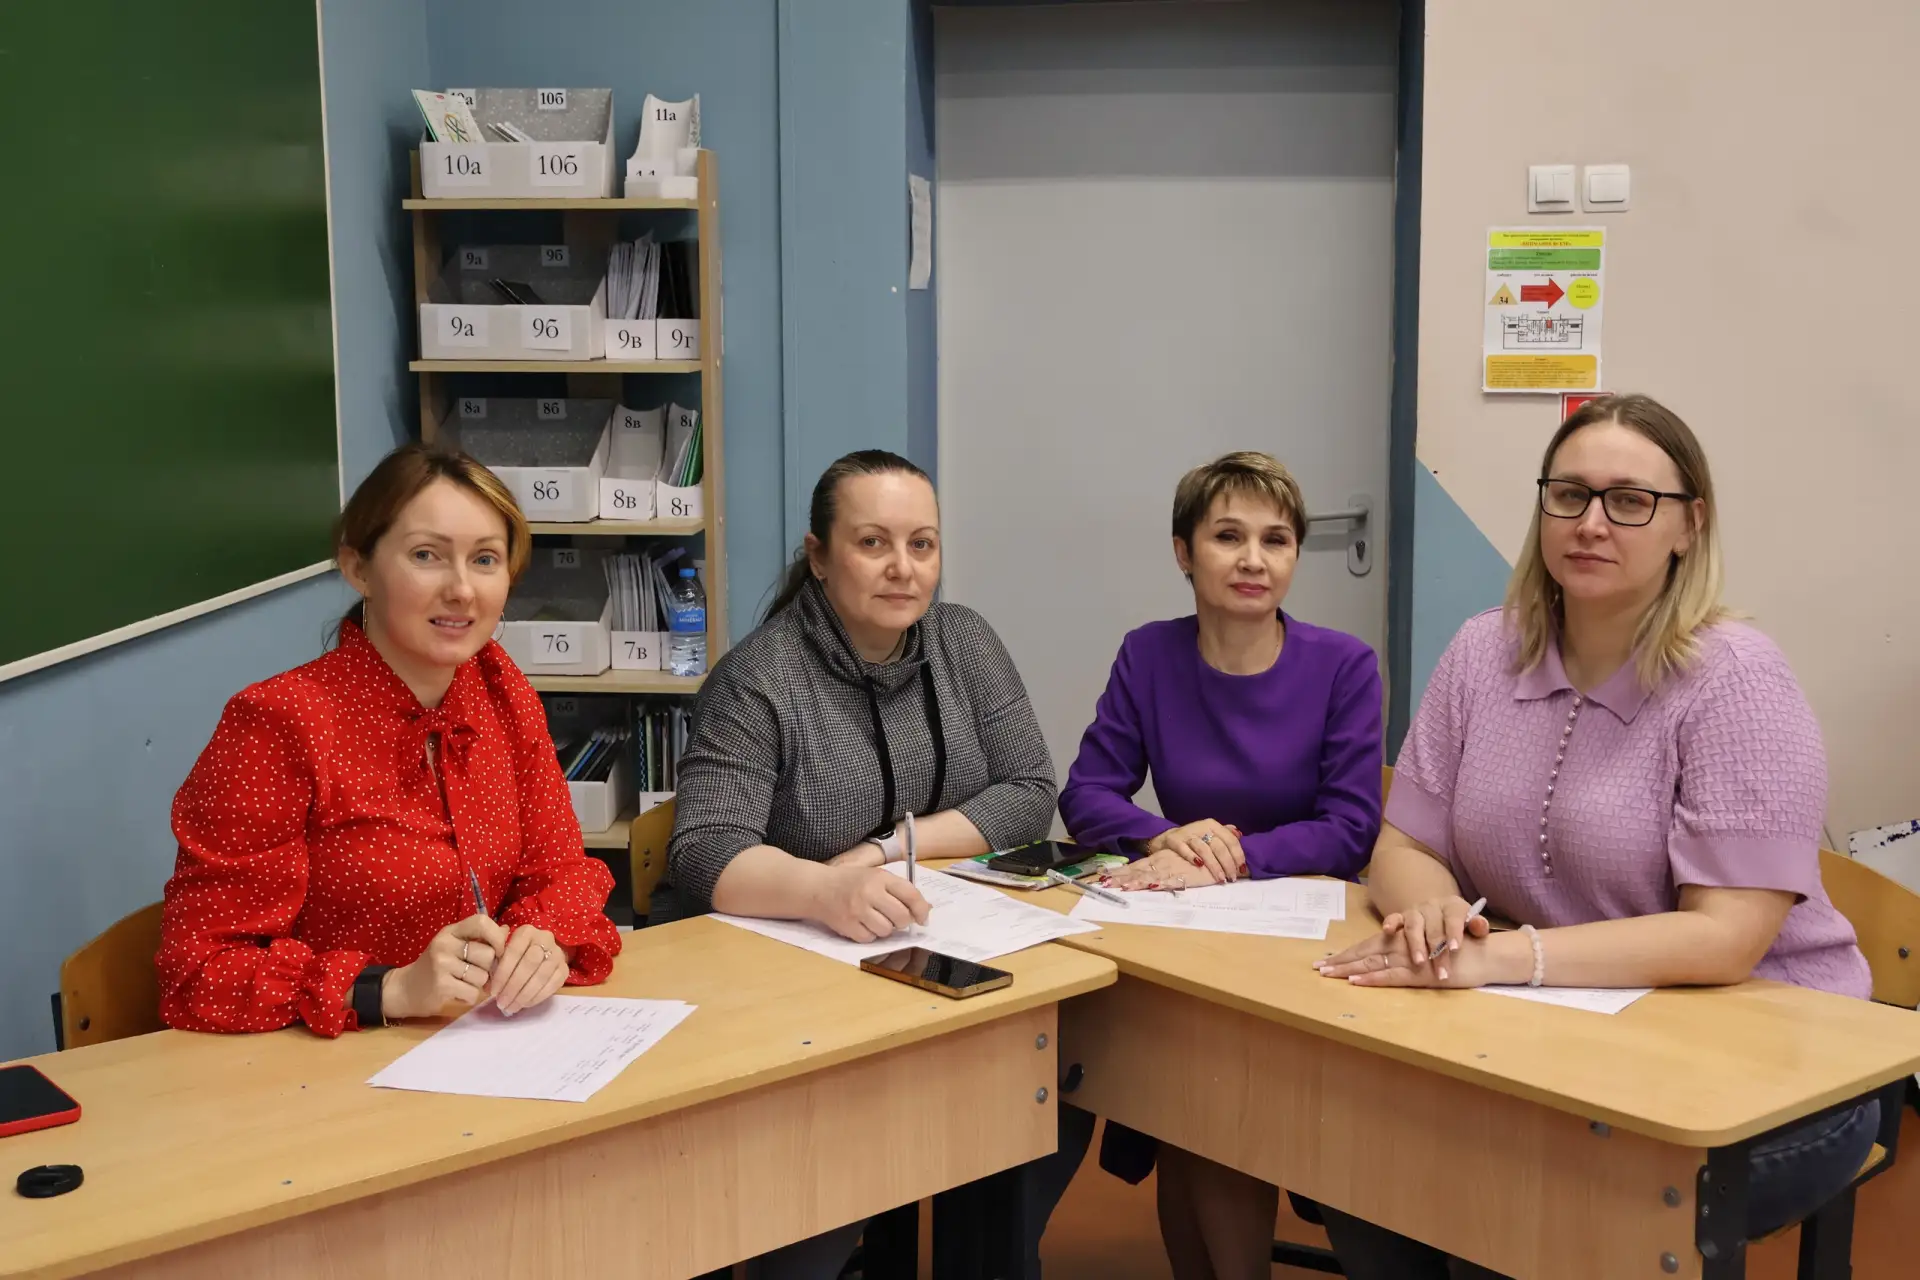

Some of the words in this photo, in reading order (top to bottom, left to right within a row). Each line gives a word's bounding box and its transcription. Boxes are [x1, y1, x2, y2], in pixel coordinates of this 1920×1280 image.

[540, 93, 564, 105] 10б
[655, 109, 677, 121] 11а
[445, 155, 482, 175] 10а
[538, 154, 578, 175] 10б
[466, 252, 482, 265] 9а
[546, 249, 563, 261] 9б
[451, 316, 475, 337] 9а
[532, 317, 560, 338] 9б
[618, 329, 642, 349] 9в
[671, 329, 694, 348] 9г
[464, 401, 481, 414] 8а
[543, 402, 560, 415] 8б
[624, 415, 642, 429] 8в
[533, 480, 560, 500] 8б
[613, 489, 637, 509] 8в
[671, 497, 693, 516] 8г
[558, 552, 575, 564] 7б
[543, 633, 570, 653] 7б
[624, 641, 648, 660] 7в
